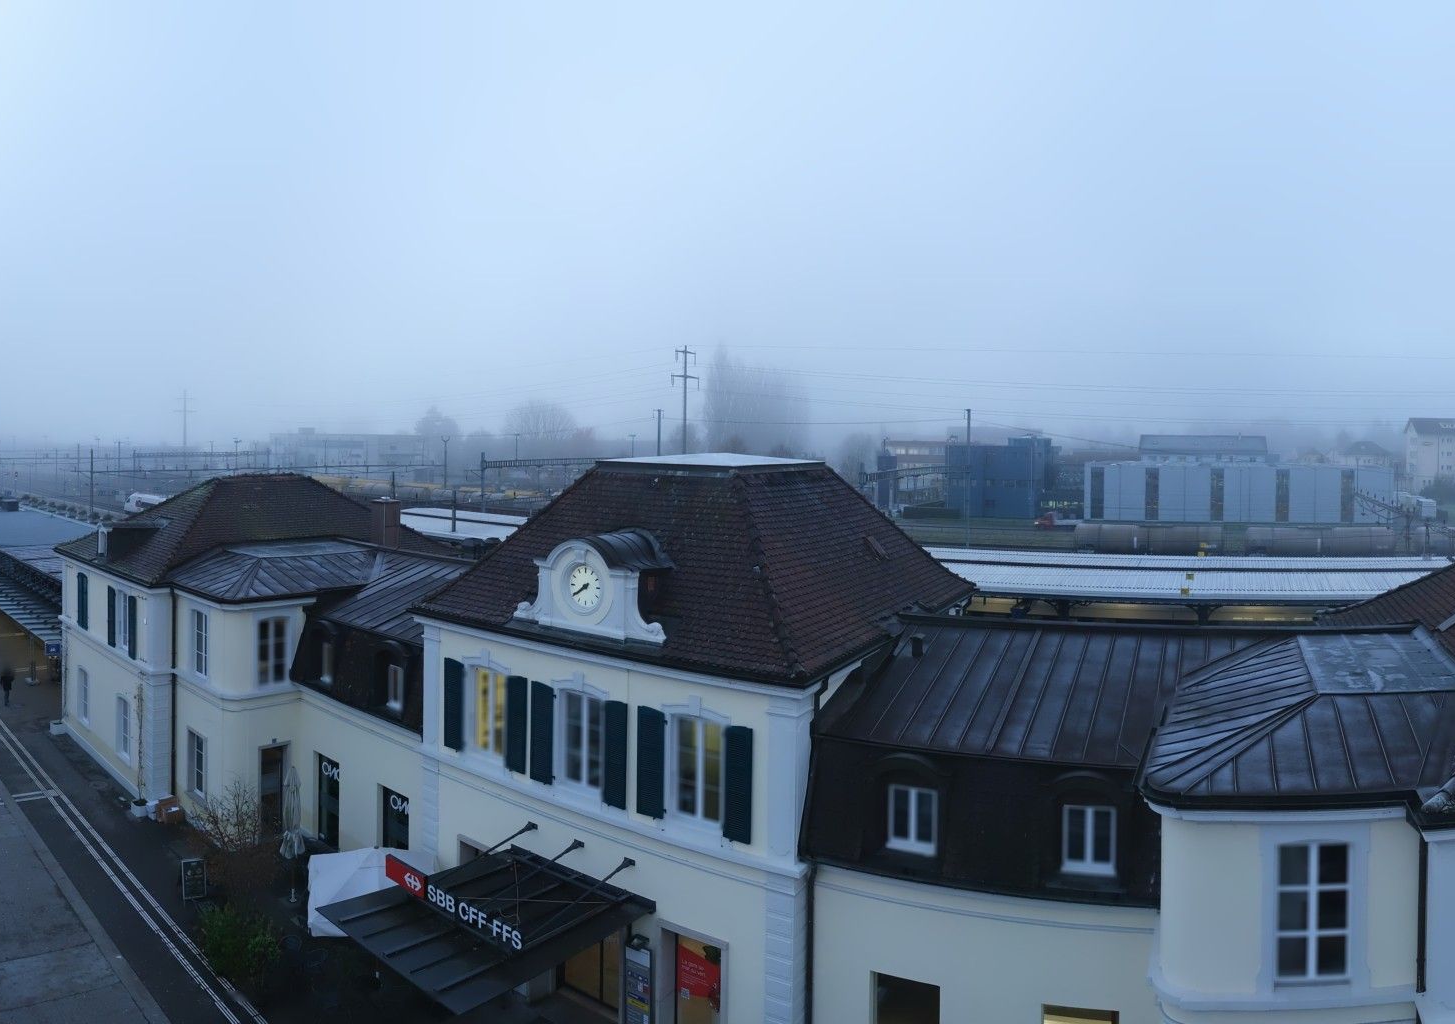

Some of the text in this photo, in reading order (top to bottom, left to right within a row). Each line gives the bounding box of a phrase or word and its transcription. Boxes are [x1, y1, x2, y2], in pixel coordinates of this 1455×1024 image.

[427, 884, 522, 950] SBB CFF FFS
